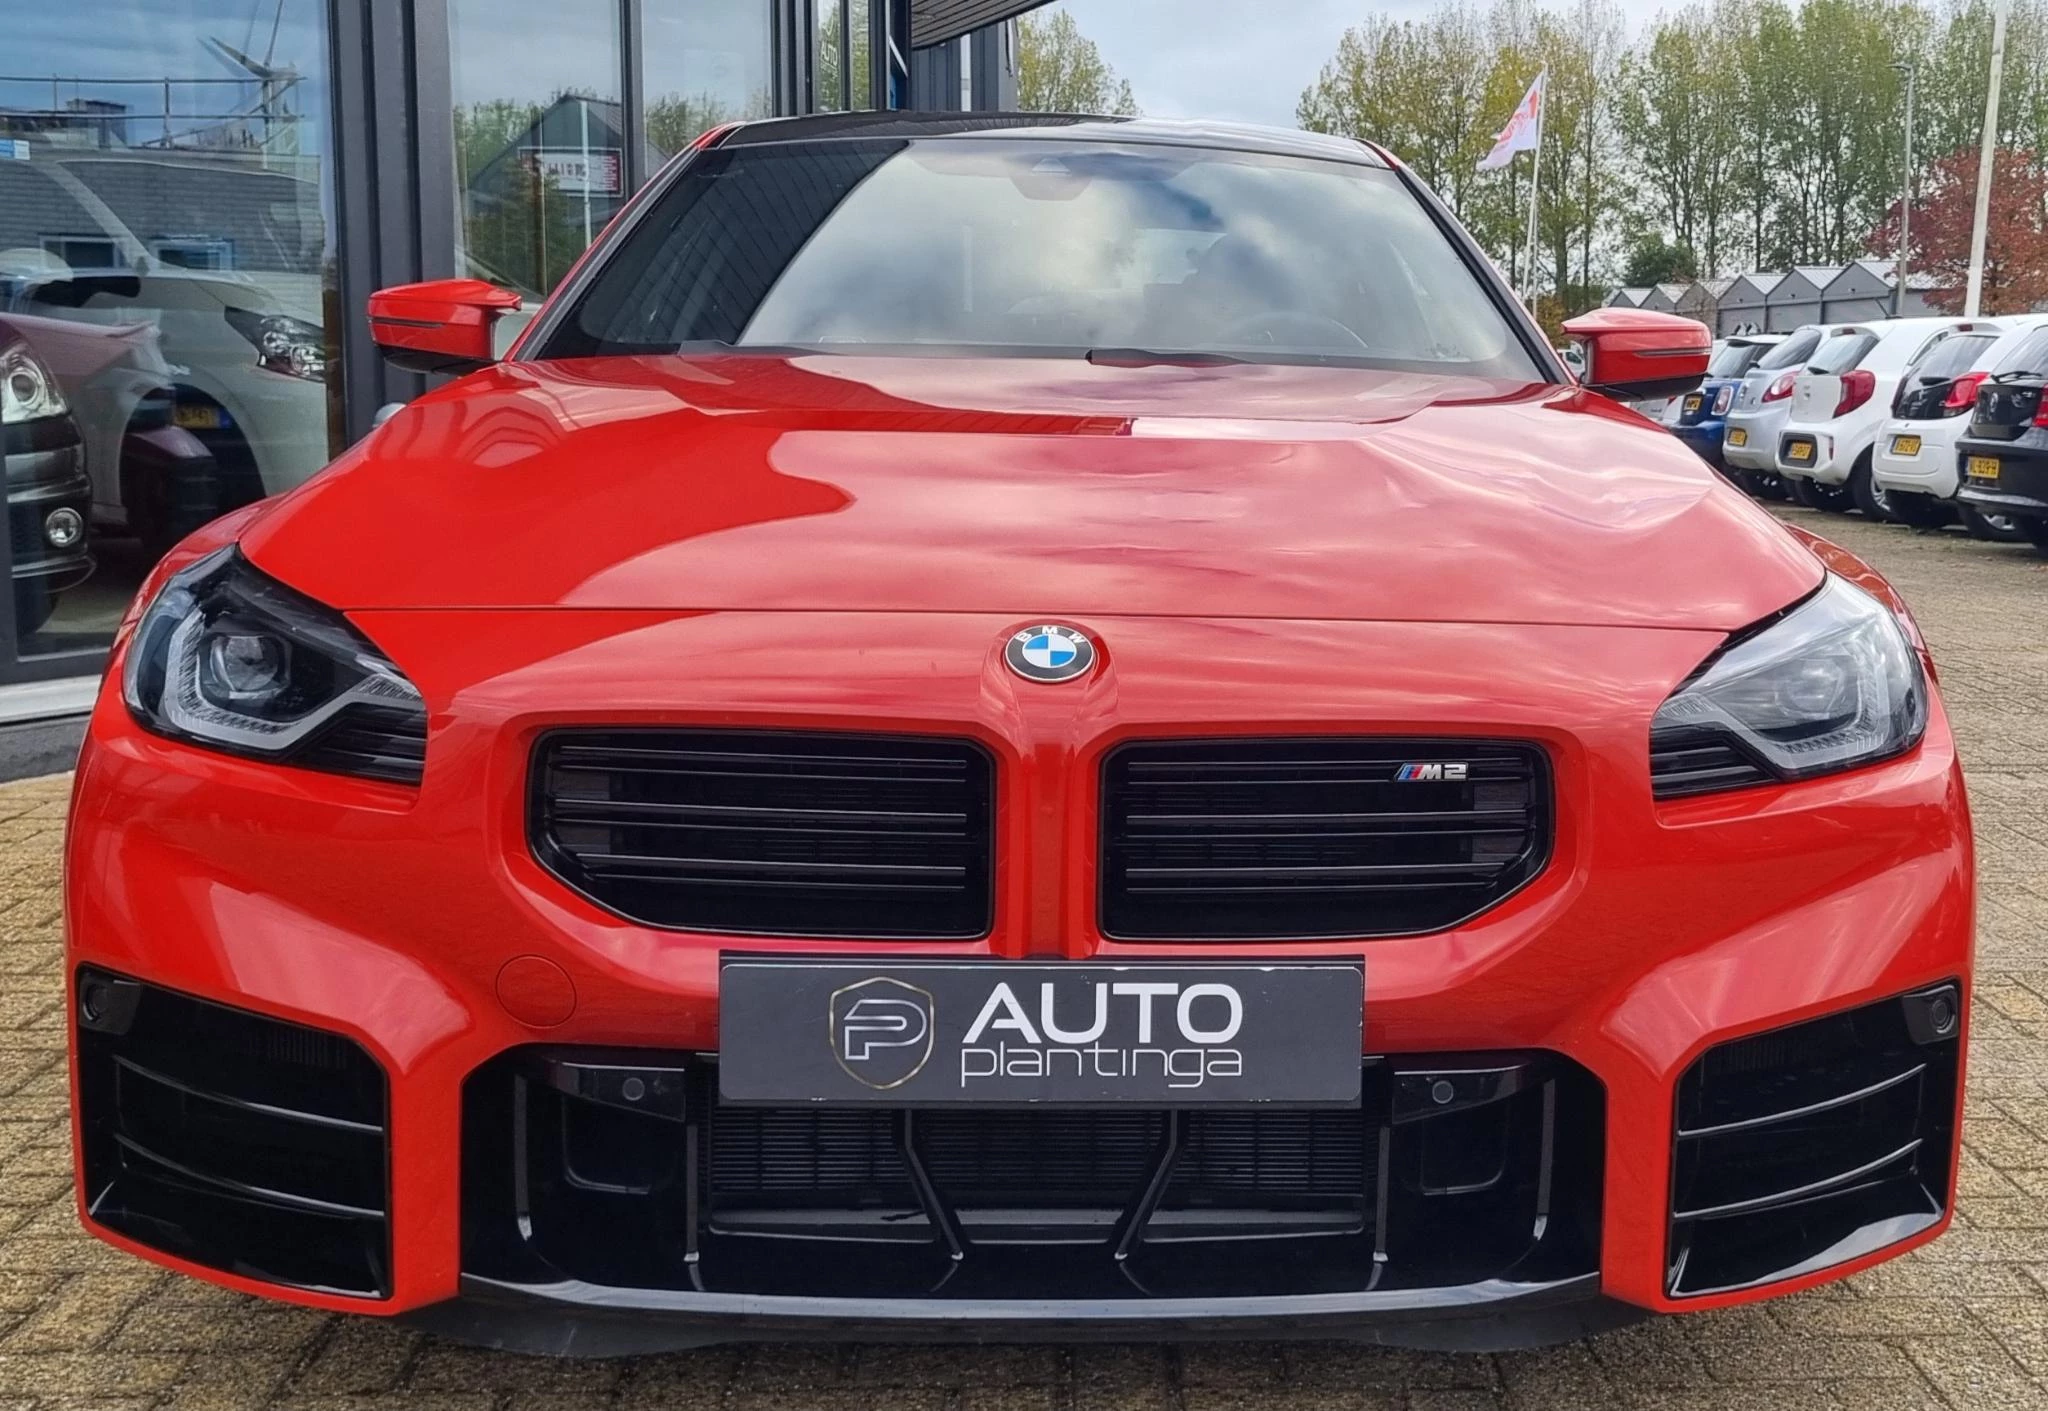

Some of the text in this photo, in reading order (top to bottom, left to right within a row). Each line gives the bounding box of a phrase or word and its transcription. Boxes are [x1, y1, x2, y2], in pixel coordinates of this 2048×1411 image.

[1014, 625, 1087, 643] BMW
[1418, 763, 1467, 780] M2
[962, 982, 1243, 1044] AUTO
[961, 1041, 1243, 1089] plantinga
